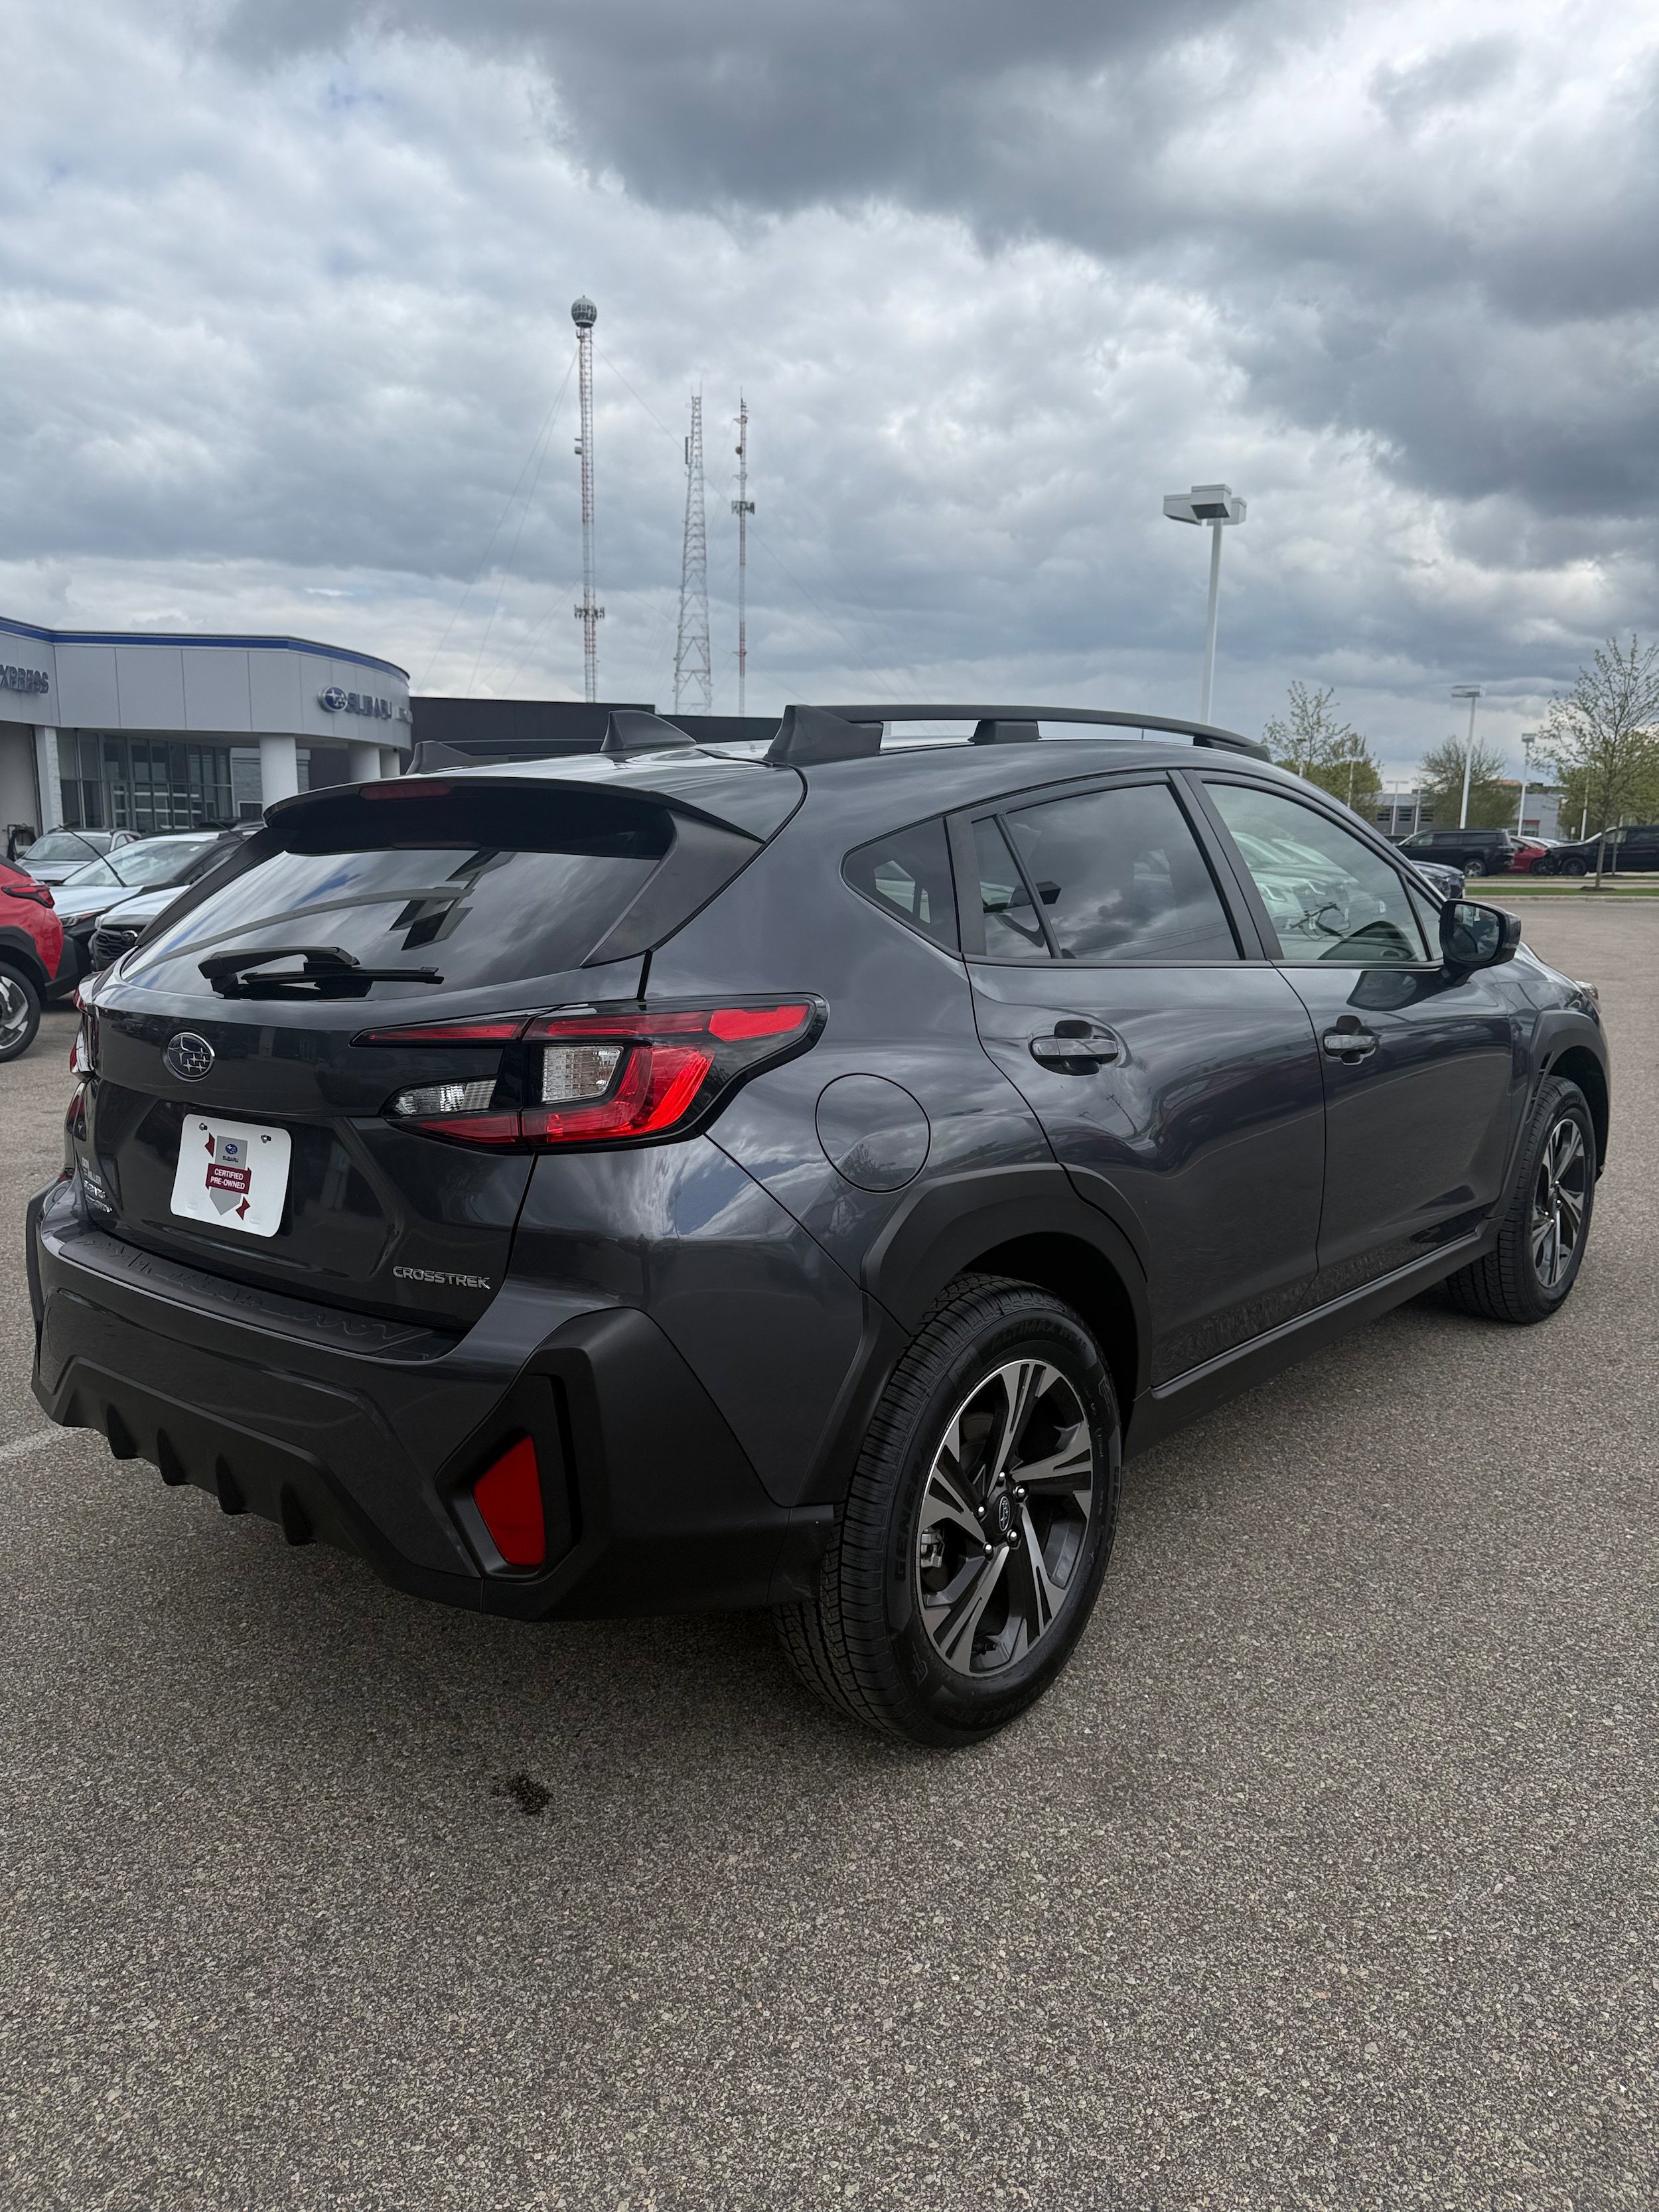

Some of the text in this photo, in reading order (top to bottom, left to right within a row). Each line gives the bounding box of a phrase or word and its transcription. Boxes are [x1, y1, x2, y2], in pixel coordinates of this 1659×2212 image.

[0, 664, 49, 694] XPRESS
[348, 692, 392, 719] SUBARU
[210, 1176, 246, 1189] PRE-OWNED
[214, 1168, 244, 1181] CERTIFIED
[392, 1266, 491, 1290] CROSSTREK
